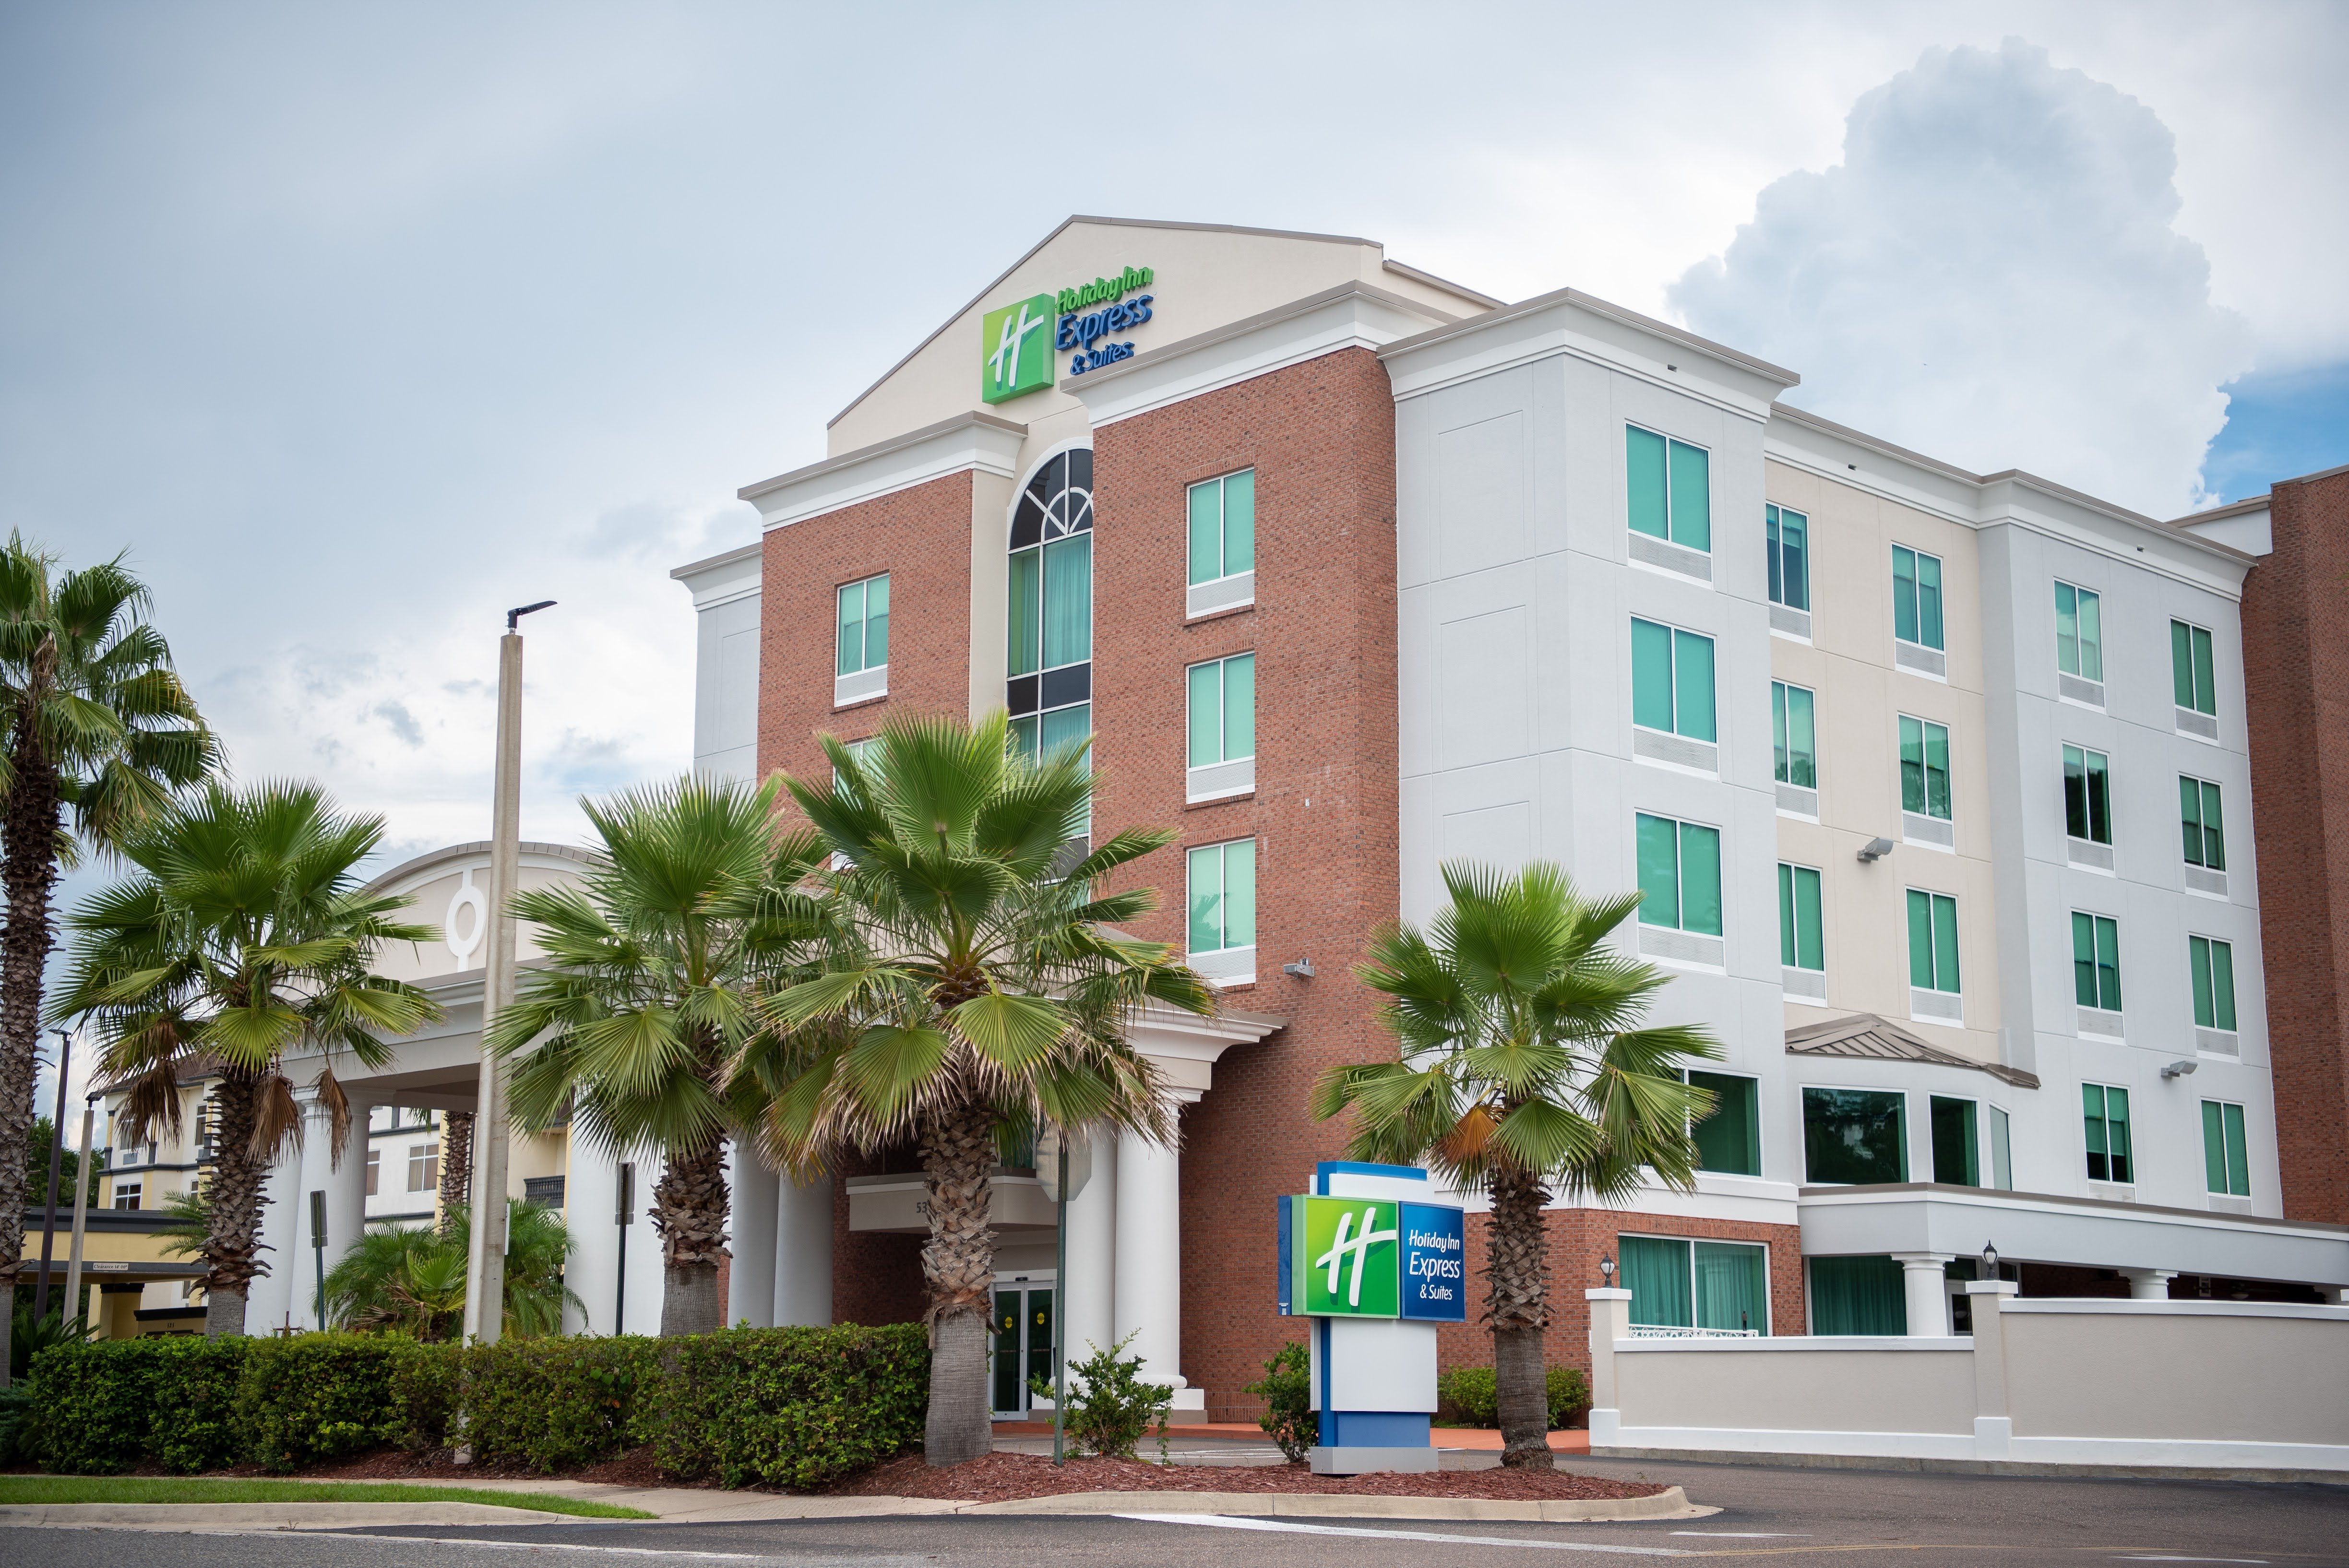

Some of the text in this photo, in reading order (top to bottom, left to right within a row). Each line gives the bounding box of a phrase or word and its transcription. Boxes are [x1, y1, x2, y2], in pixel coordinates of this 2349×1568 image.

[1055, 266, 1153, 315] Holiday Inn
[1055, 295, 1154, 350] Express
[1070, 342, 1135, 375] & Suites
[1408, 1229, 1460, 1253] Holiday Inn
[1409, 1251, 1460, 1283] Express
[1419, 1283, 1453, 1300] & Suites
